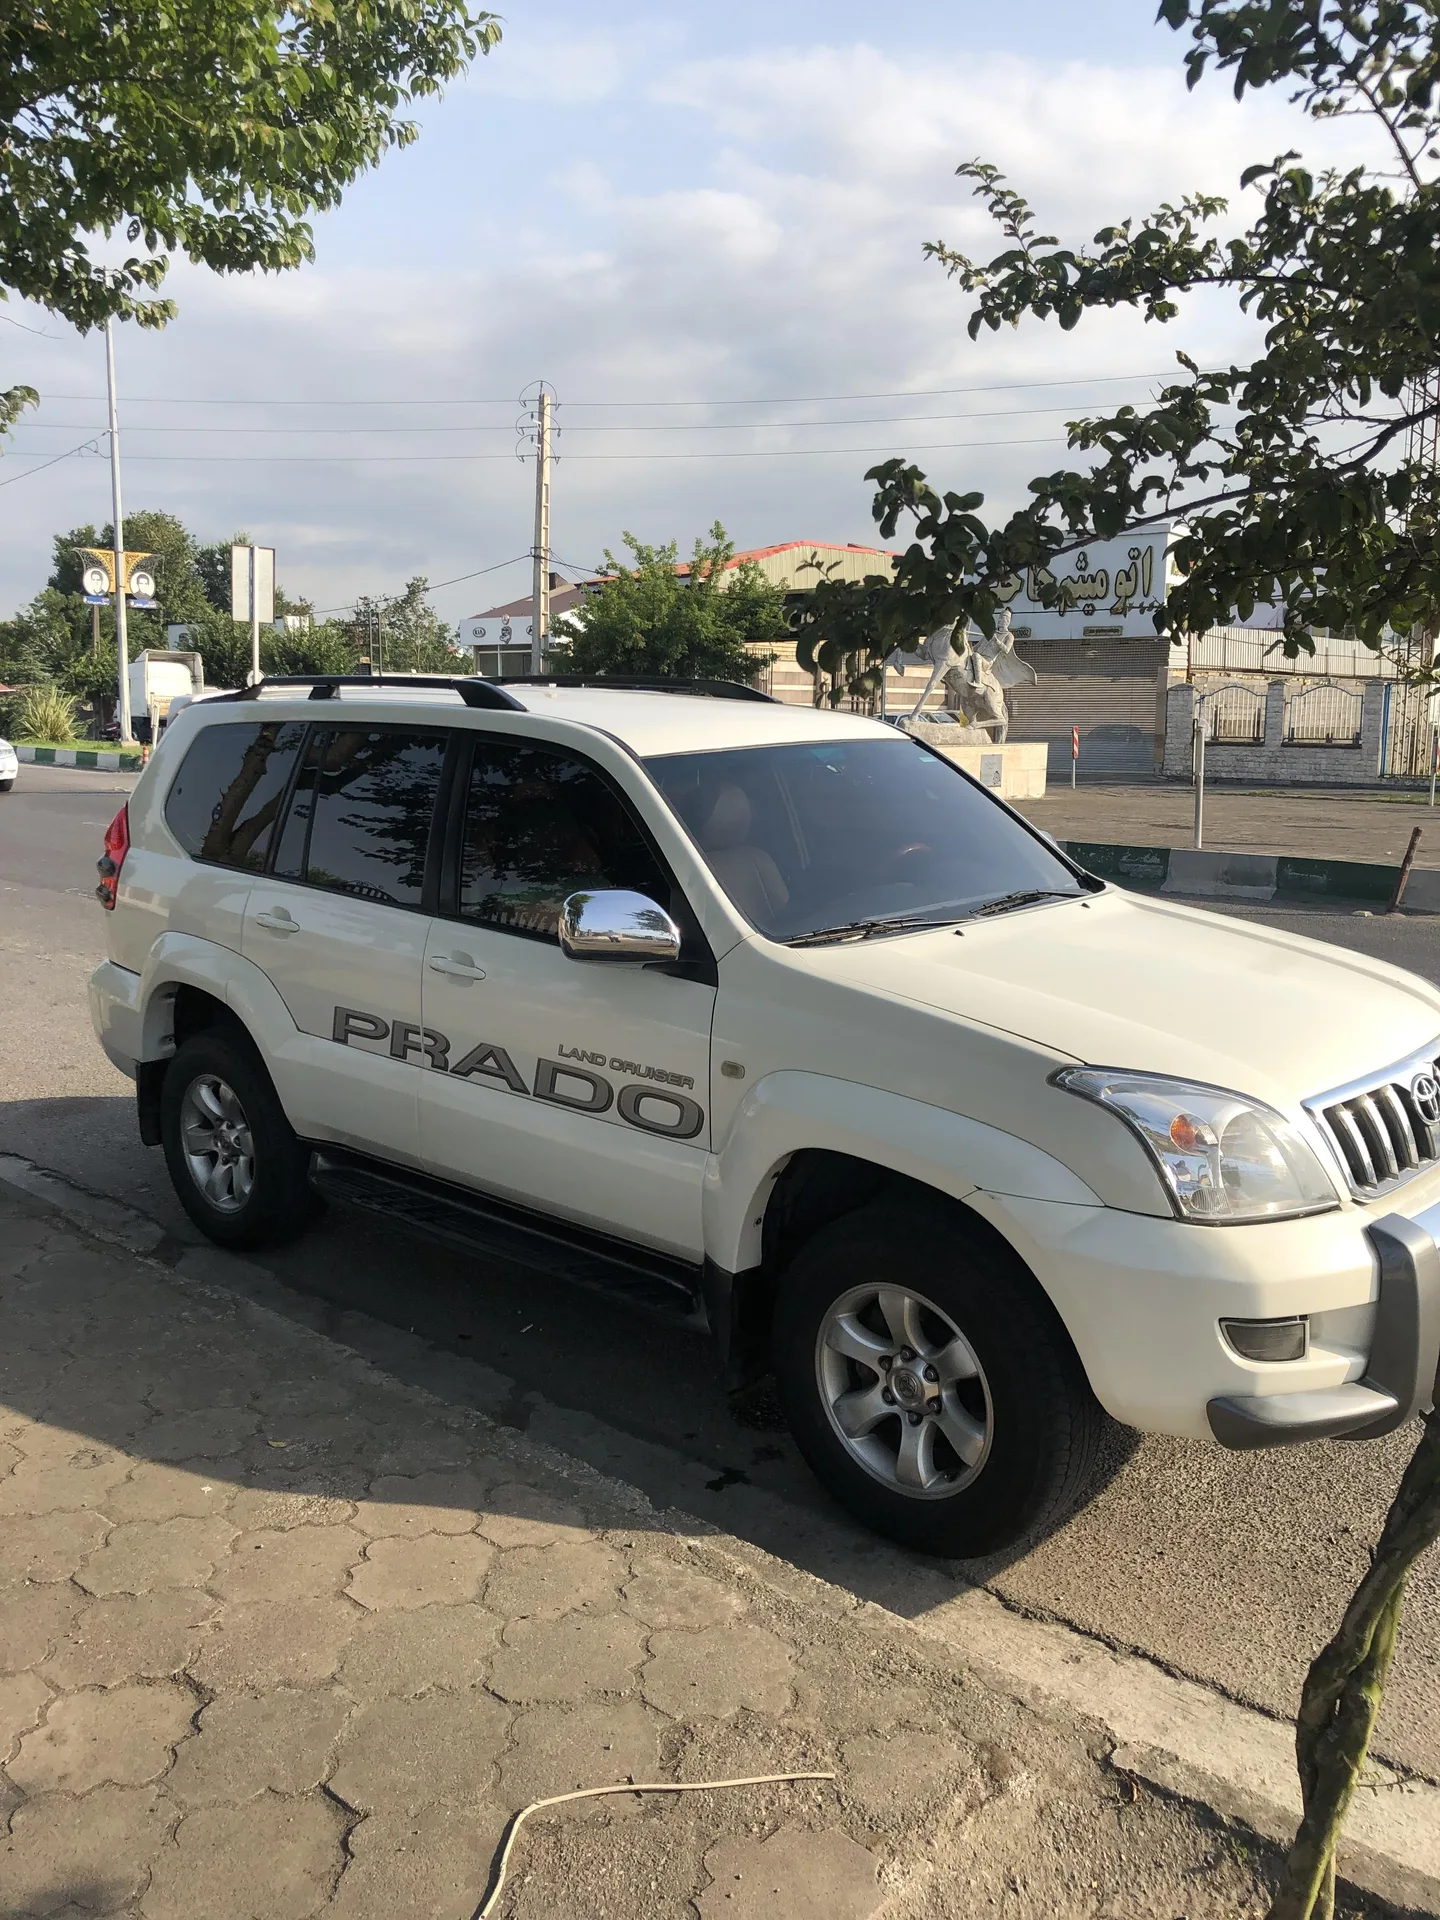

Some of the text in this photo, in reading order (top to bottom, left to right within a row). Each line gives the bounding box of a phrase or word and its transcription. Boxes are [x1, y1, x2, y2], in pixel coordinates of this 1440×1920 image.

[332, 1006, 705, 1139] PRADO
[557, 1044, 695, 1090] LAND CRUISER
